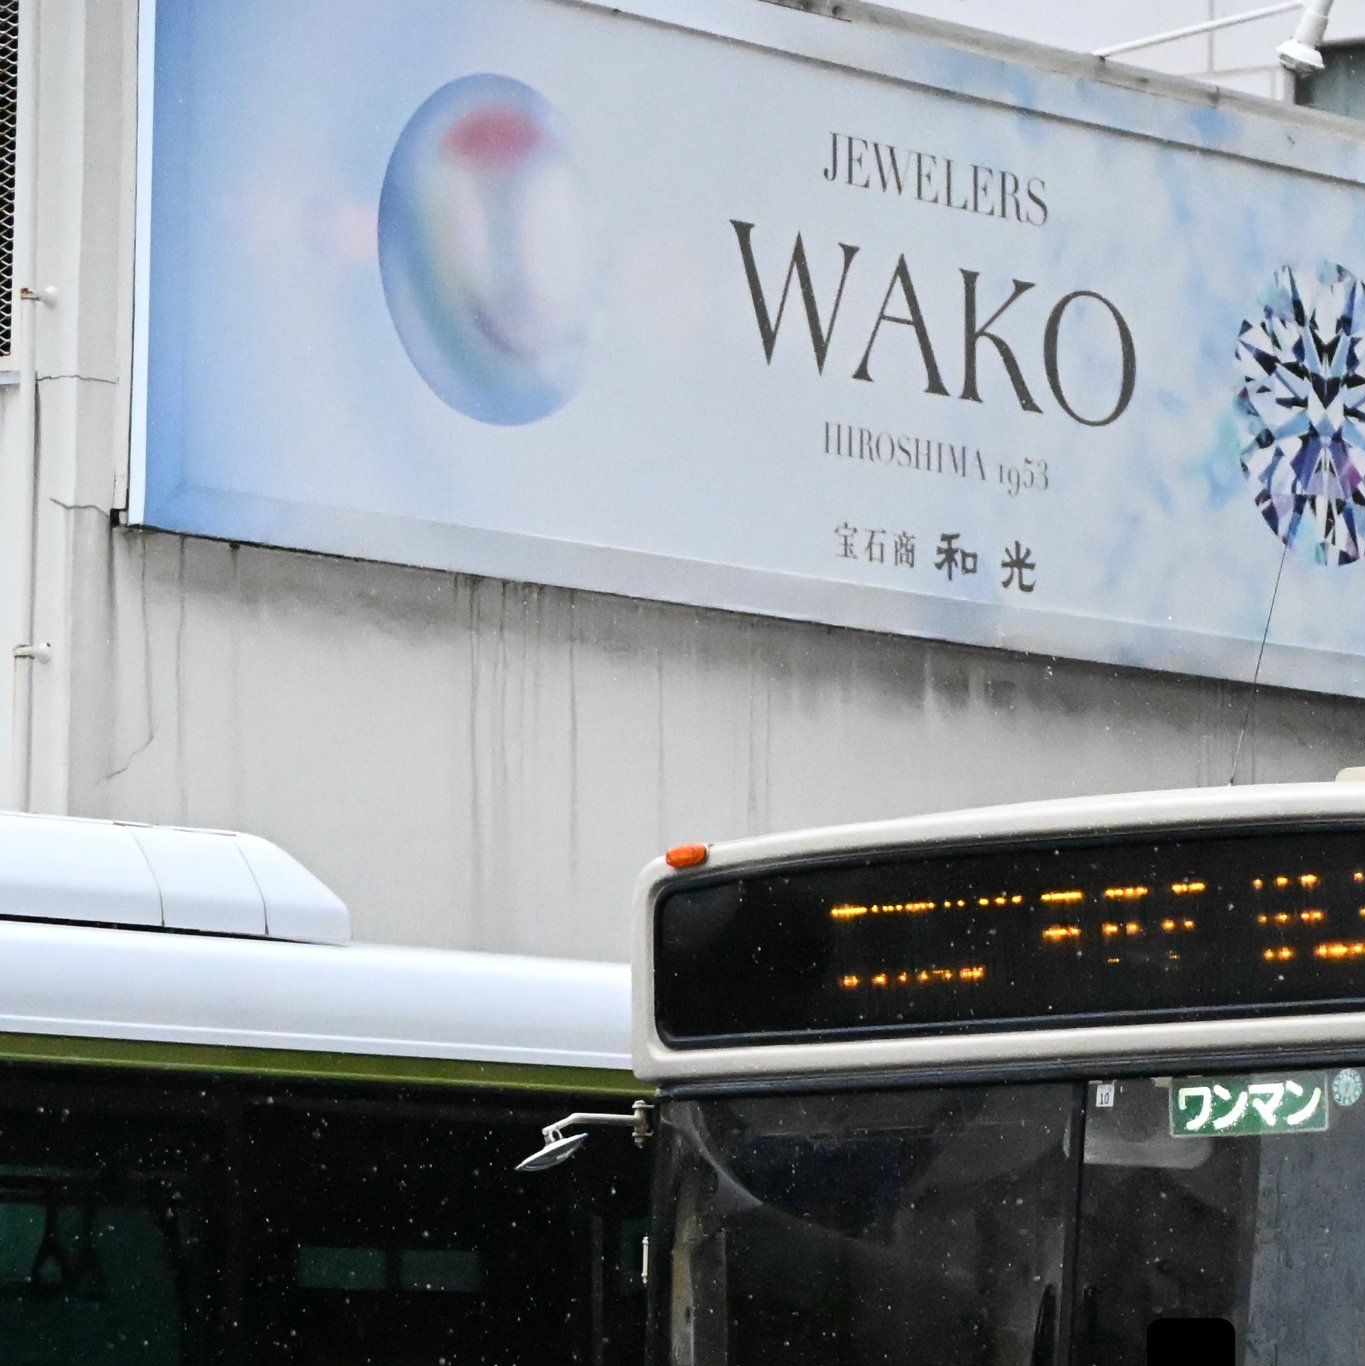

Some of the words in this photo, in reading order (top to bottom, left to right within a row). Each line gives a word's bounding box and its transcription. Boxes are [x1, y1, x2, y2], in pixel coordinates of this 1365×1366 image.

[824, 132, 1048, 226] JEWELERS
[729, 219, 1136, 427] WAKO
[823, 421, 987, 482] HIROSHIMA
[996, 461, 1049, 498] 1953
[834, 521, 916, 569] 宝石商
[934, 532, 1037, 593] 和光
[1178, 1079, 1322, 1131] ワンマン
